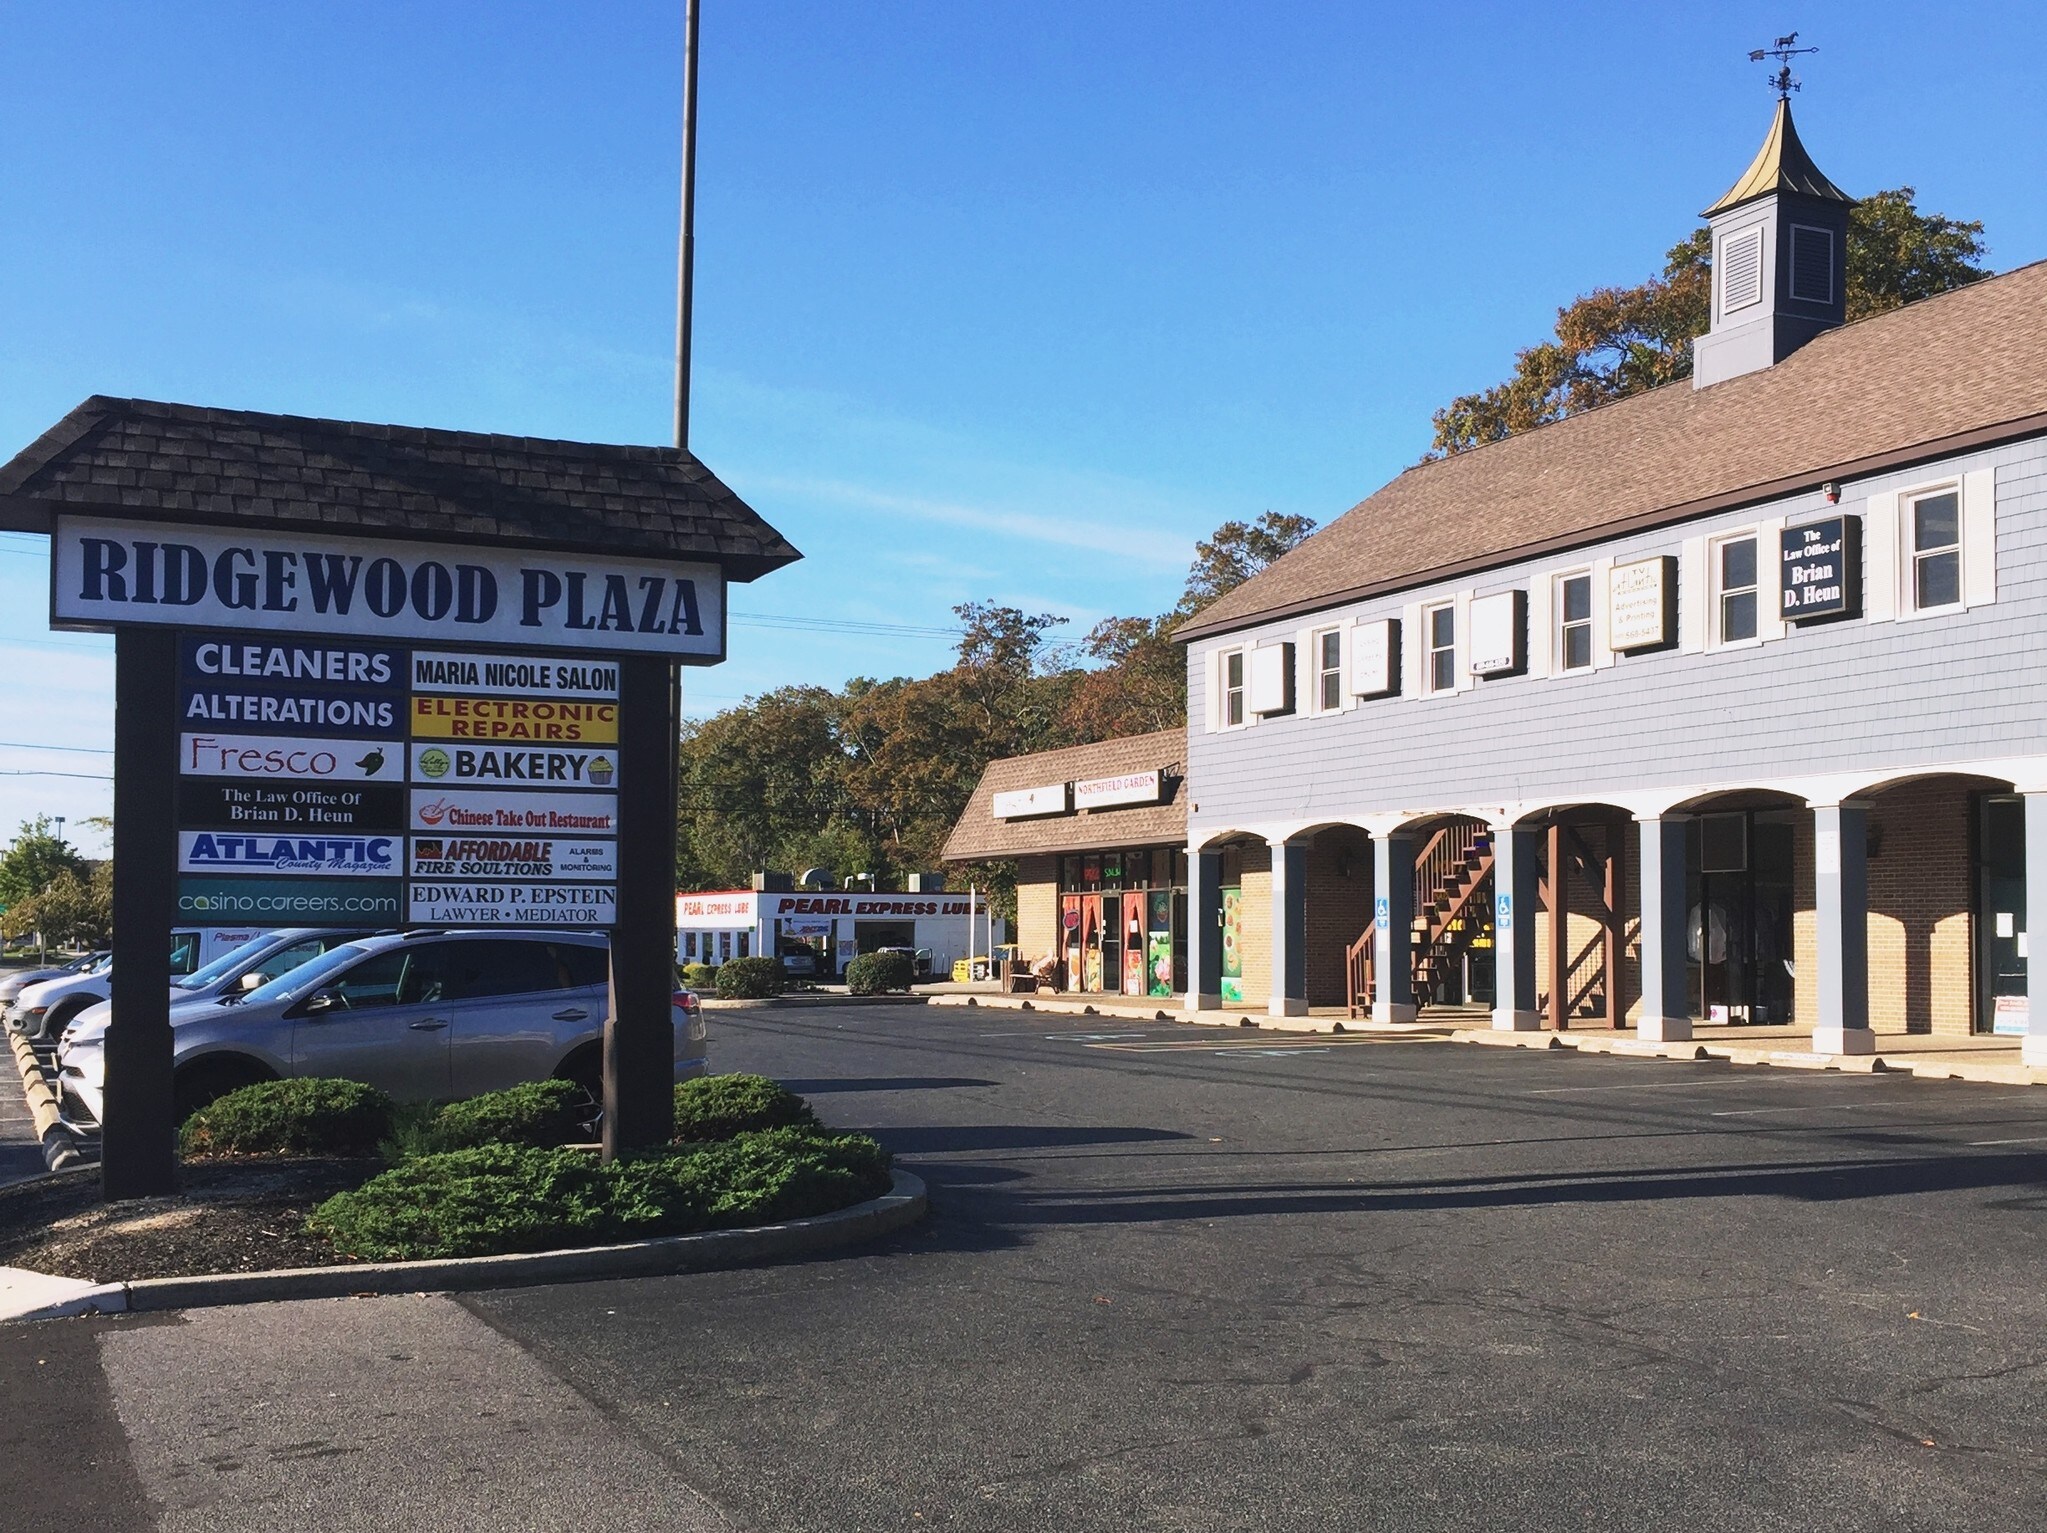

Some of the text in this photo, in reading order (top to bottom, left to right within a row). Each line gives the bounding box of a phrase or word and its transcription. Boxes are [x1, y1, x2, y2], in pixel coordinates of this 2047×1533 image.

[1803, 530, 1821, 542] The
[1783, 539, 1841, 561] Law Office of
[1791, 563, 1833, 585] Brian
[79, 537, 704, 635] RIDGEWOOD PLAZA
[1784, 585, 1840, 608] D. Heun
[195, 643, 391, 683] CLEANERS
[416, 660, 616, 691] MARIA NICOLE SALON
[187, 693, 393, 727] ALTERATIONS
[417, 699, 614, 722] ELECTRONIC
[452, 720, 581, 740] REPAIRS
[192, 738, 337, 775] Fresco
[456, 750, 588, 780] BAKERY
[1079, 775, 1155, 795] NORTHFIELD GARDEN
[222, 788, 362, 805] The Law Office Of
[230, 805, 353, 823] Brian D. Heun
[449, 808, 610, 829] Chinese Take Out Restaurant
[444, 840, 553, 862] AFFORDABLE
[569, 848, 604, 856] ALARMS
[275, 856, 392, 872] County Magazine
[414, 861, 553, 875] FIRE SOULTIONS
[560, 863, 612, 872] MONITORING
[412, 887, 616, 904] EDWARD P. EPSTEIN
[431, 908, 598, 922] LAWYER MEDIATOR
[684, 902, 704, 915] PEARL
[778, 898, 852, 914] PEARL
[855, 902, 937, 915] EXPRESS
